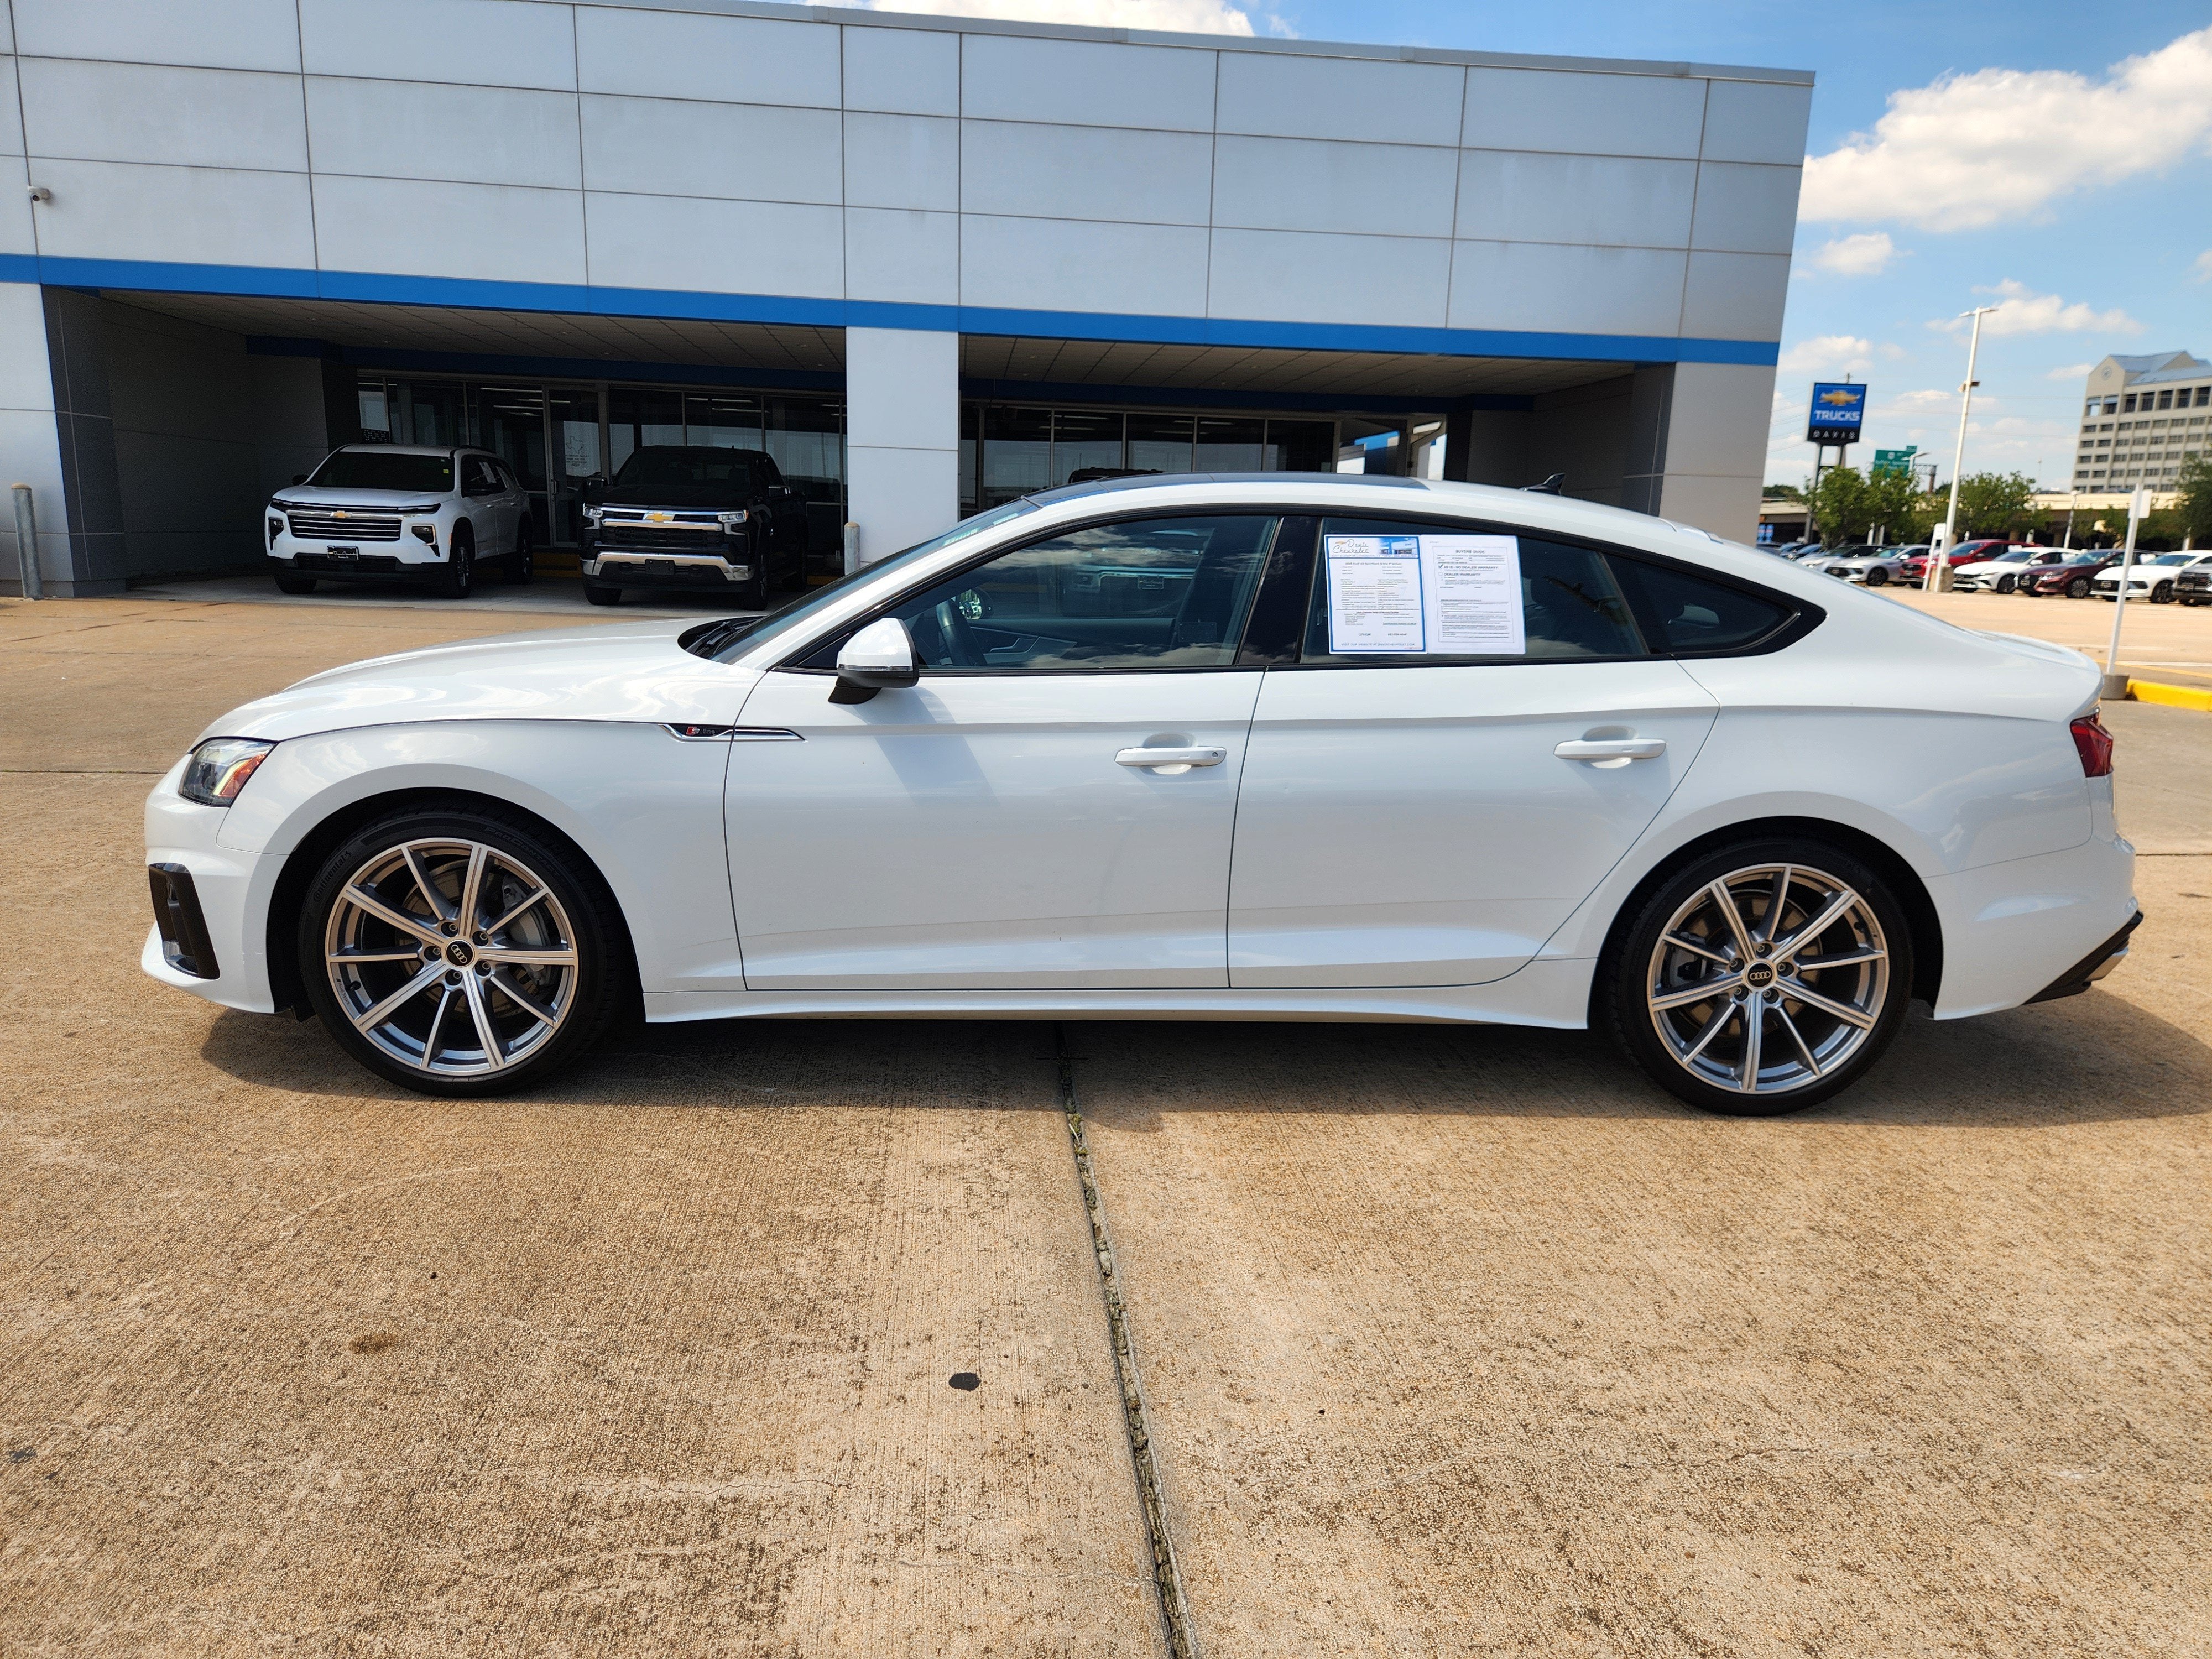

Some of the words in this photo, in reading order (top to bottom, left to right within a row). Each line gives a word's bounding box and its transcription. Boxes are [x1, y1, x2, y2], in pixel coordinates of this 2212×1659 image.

[1814, 410, 1860, 421] TRUCKS
[1813, 430, 1855, 439] DAVIS
[1347, 539, 1369, 547] Davis
[1332, 545, 1370, 554] Chevrolet
[313, 854, 347, 902] Continental
